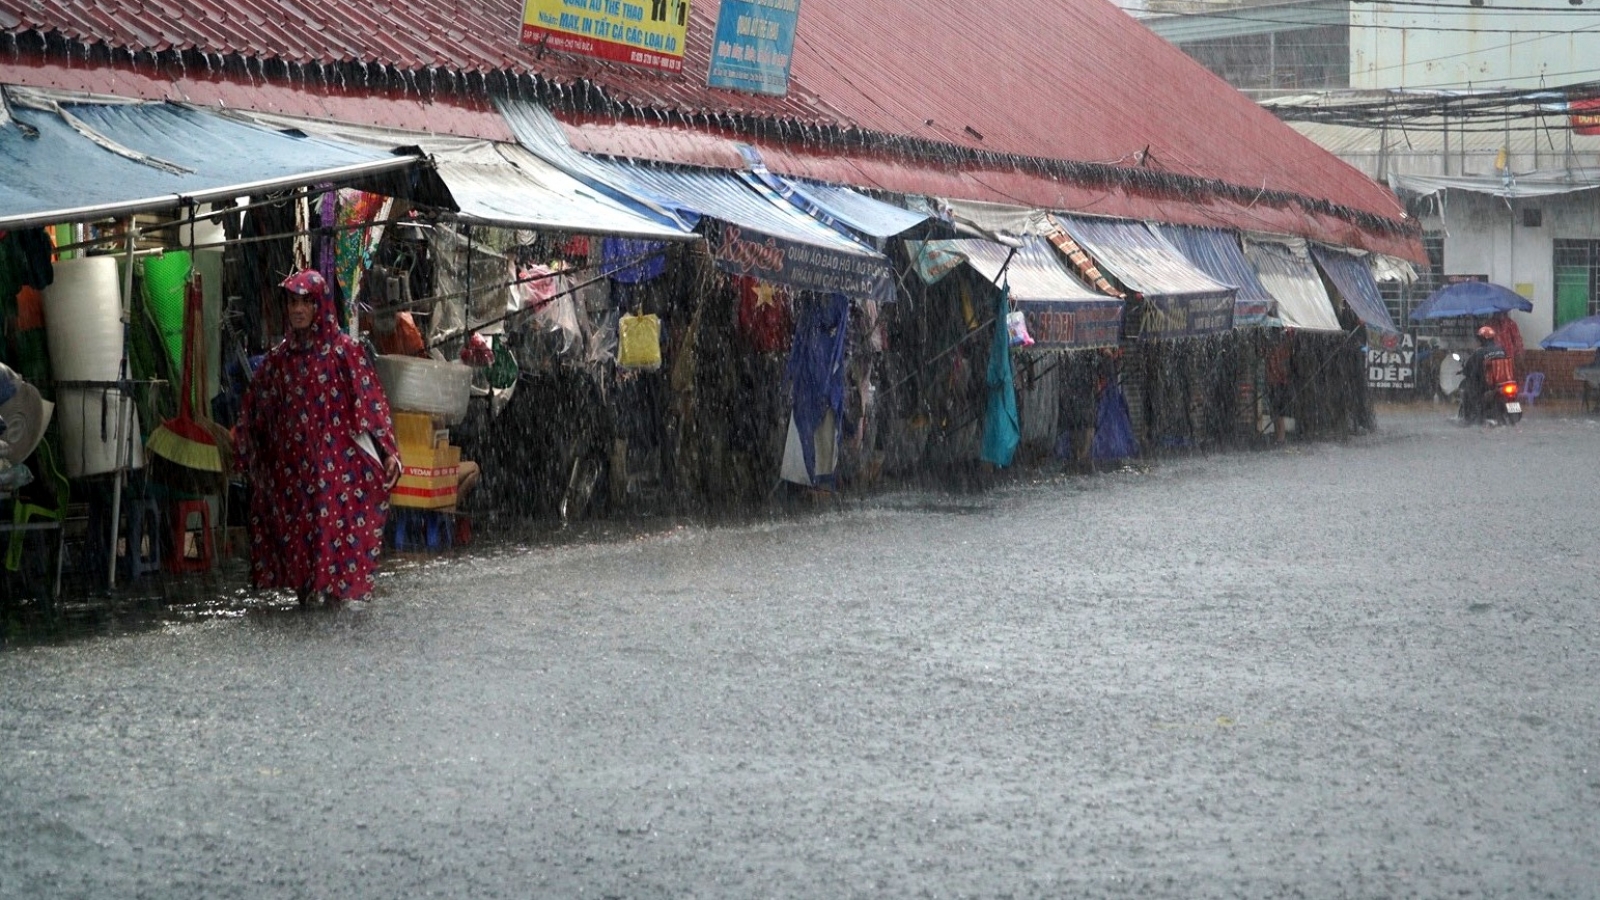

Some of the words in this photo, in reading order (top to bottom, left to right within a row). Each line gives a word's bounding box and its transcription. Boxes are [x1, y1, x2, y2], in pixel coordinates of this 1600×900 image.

[622, 2, 644, 22] THAO
[582, 17, 592, 32] IN
[594, 16, 611, 37] TẤT
[612, 20, 624, 40] CẢ
[625, 25, 643, 44] CÁC
[644, 31, 664, 51] LOẠI
[664, 33, 677, 51] ÁO
[409, 467, 432, 476] VEDAN
